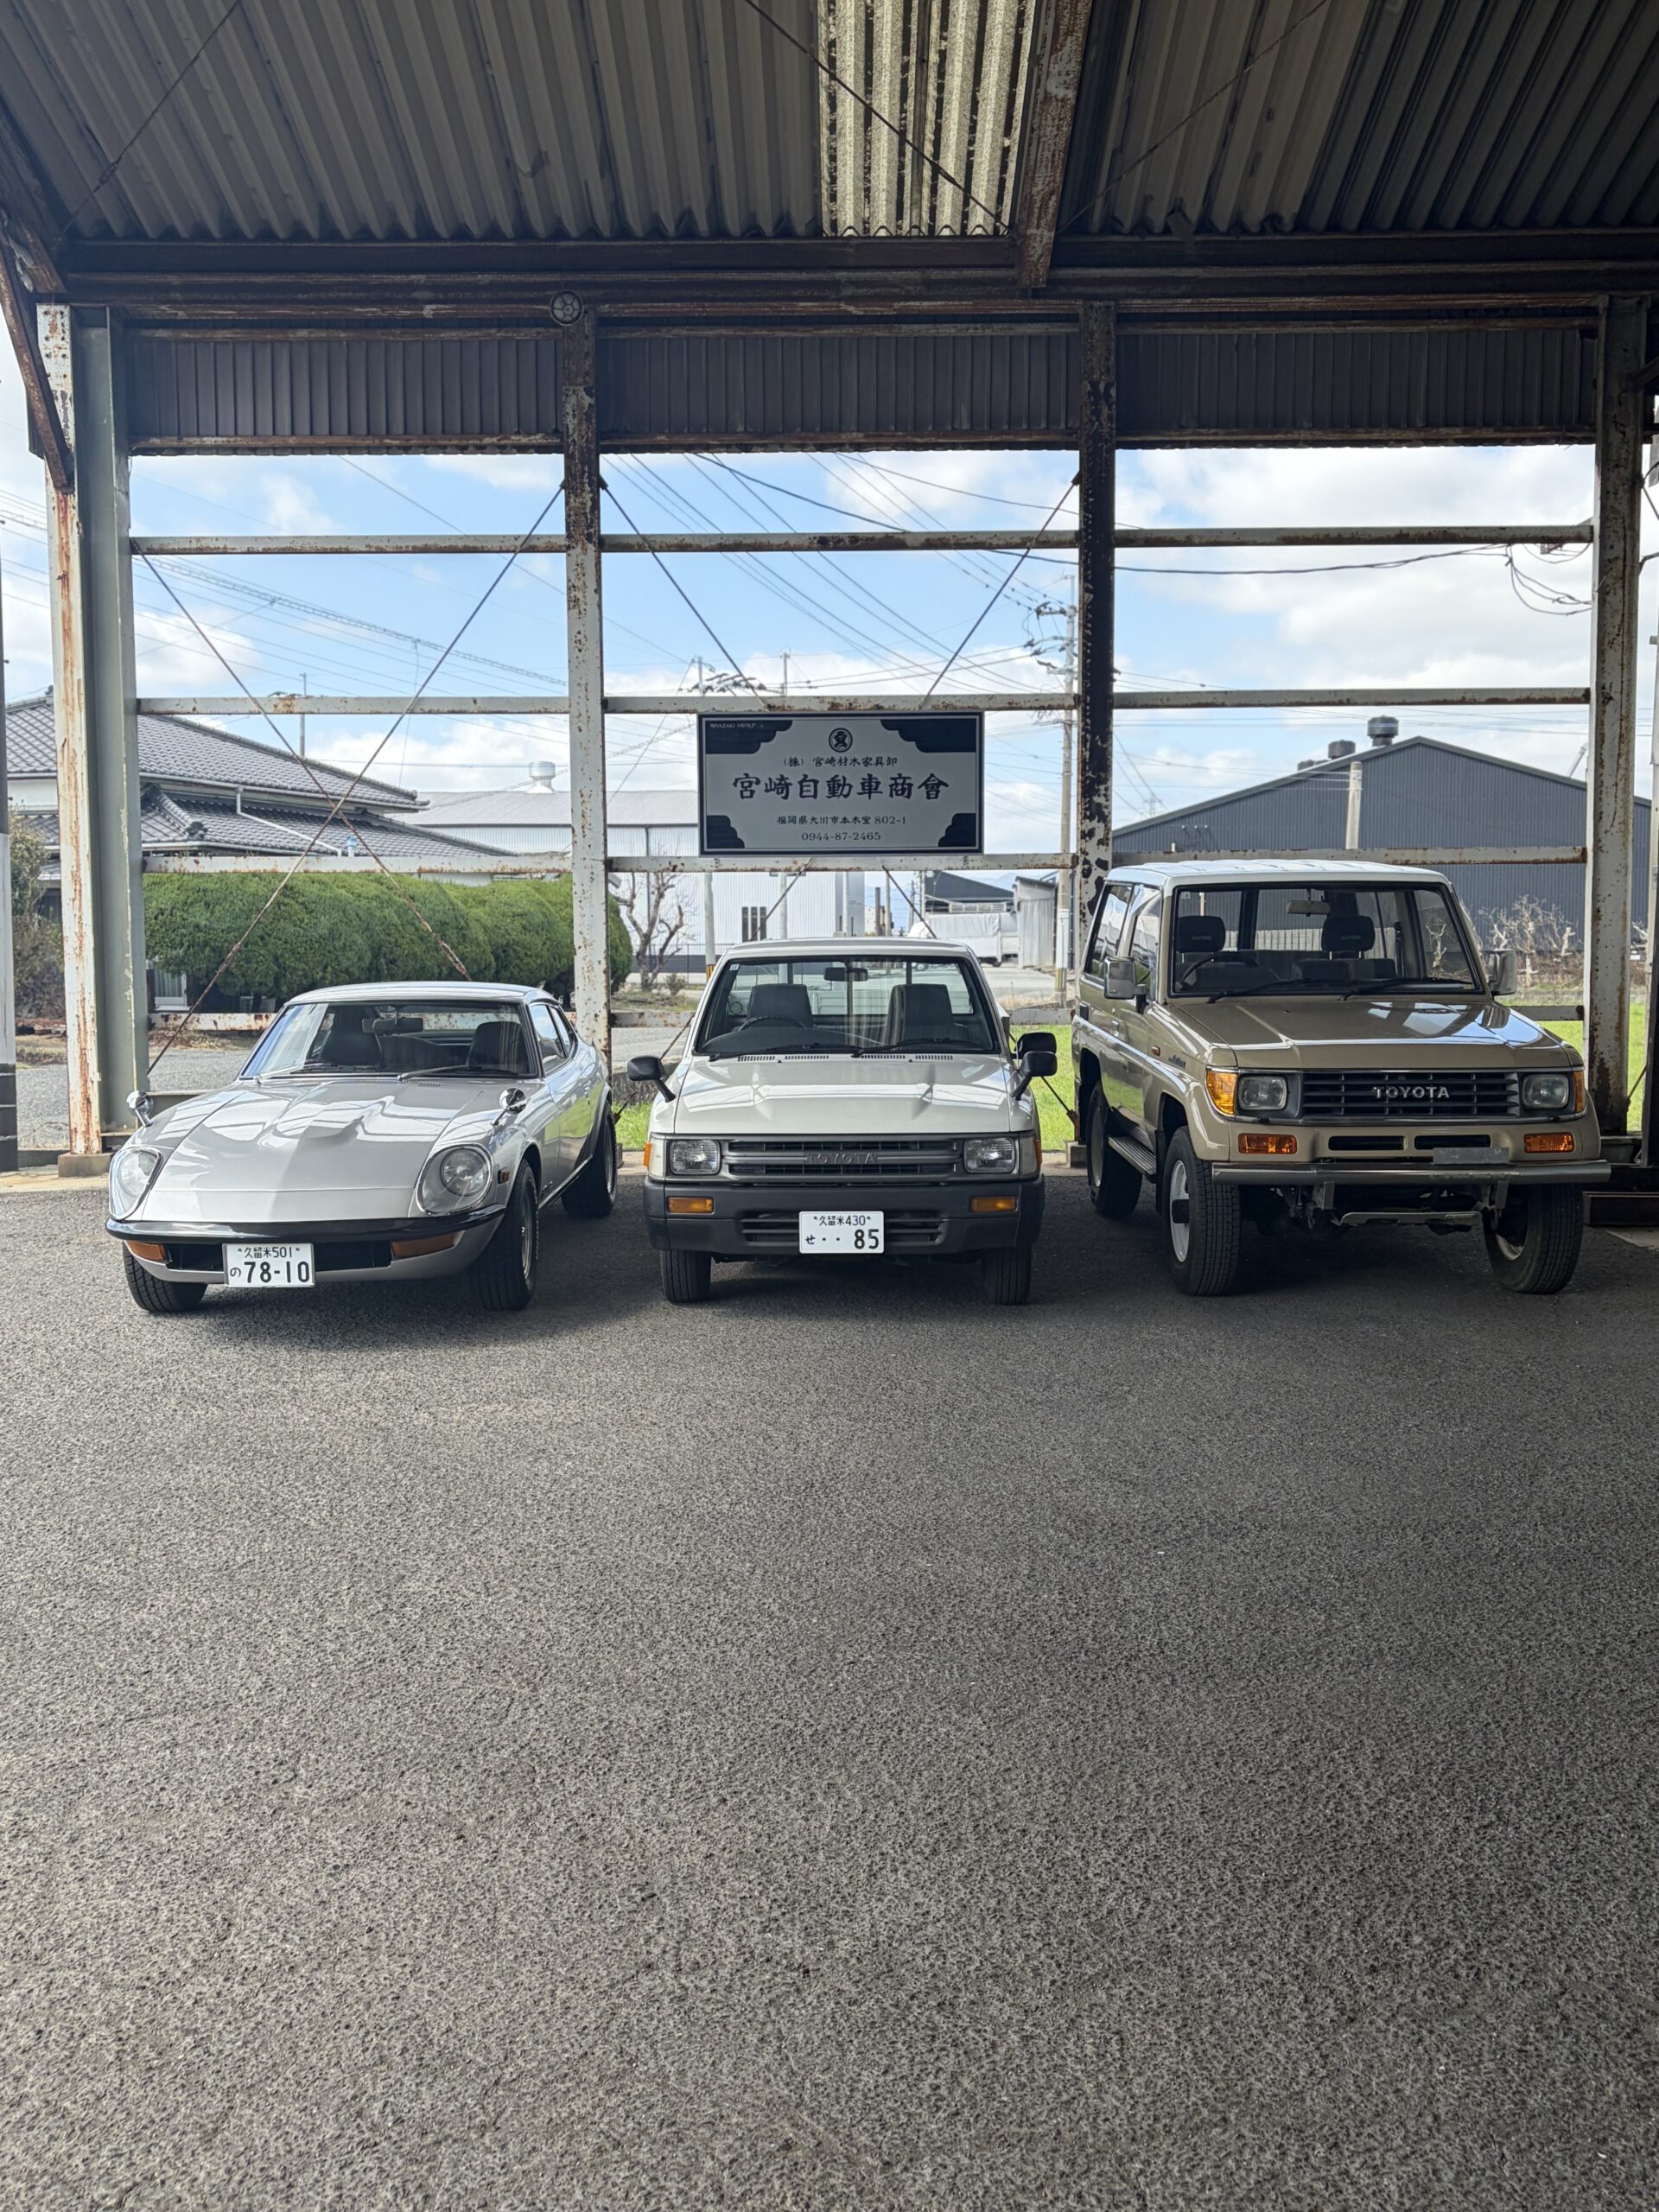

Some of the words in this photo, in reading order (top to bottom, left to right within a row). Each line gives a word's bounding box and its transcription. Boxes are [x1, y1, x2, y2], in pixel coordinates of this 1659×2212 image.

[733, 772, 950, 800] 宮崎自動車商會
[874, 816, 906, 824] 802-1
[801, 832, 881, 841] 0944-87-2465
[1372, 1086, 1450, 1098] TOYOTA
[806, 1153, 876, 1164] TOYOTA
[854, 1229, 880, 1249] 85
[244, 1261, 309, 1283] 78-10
